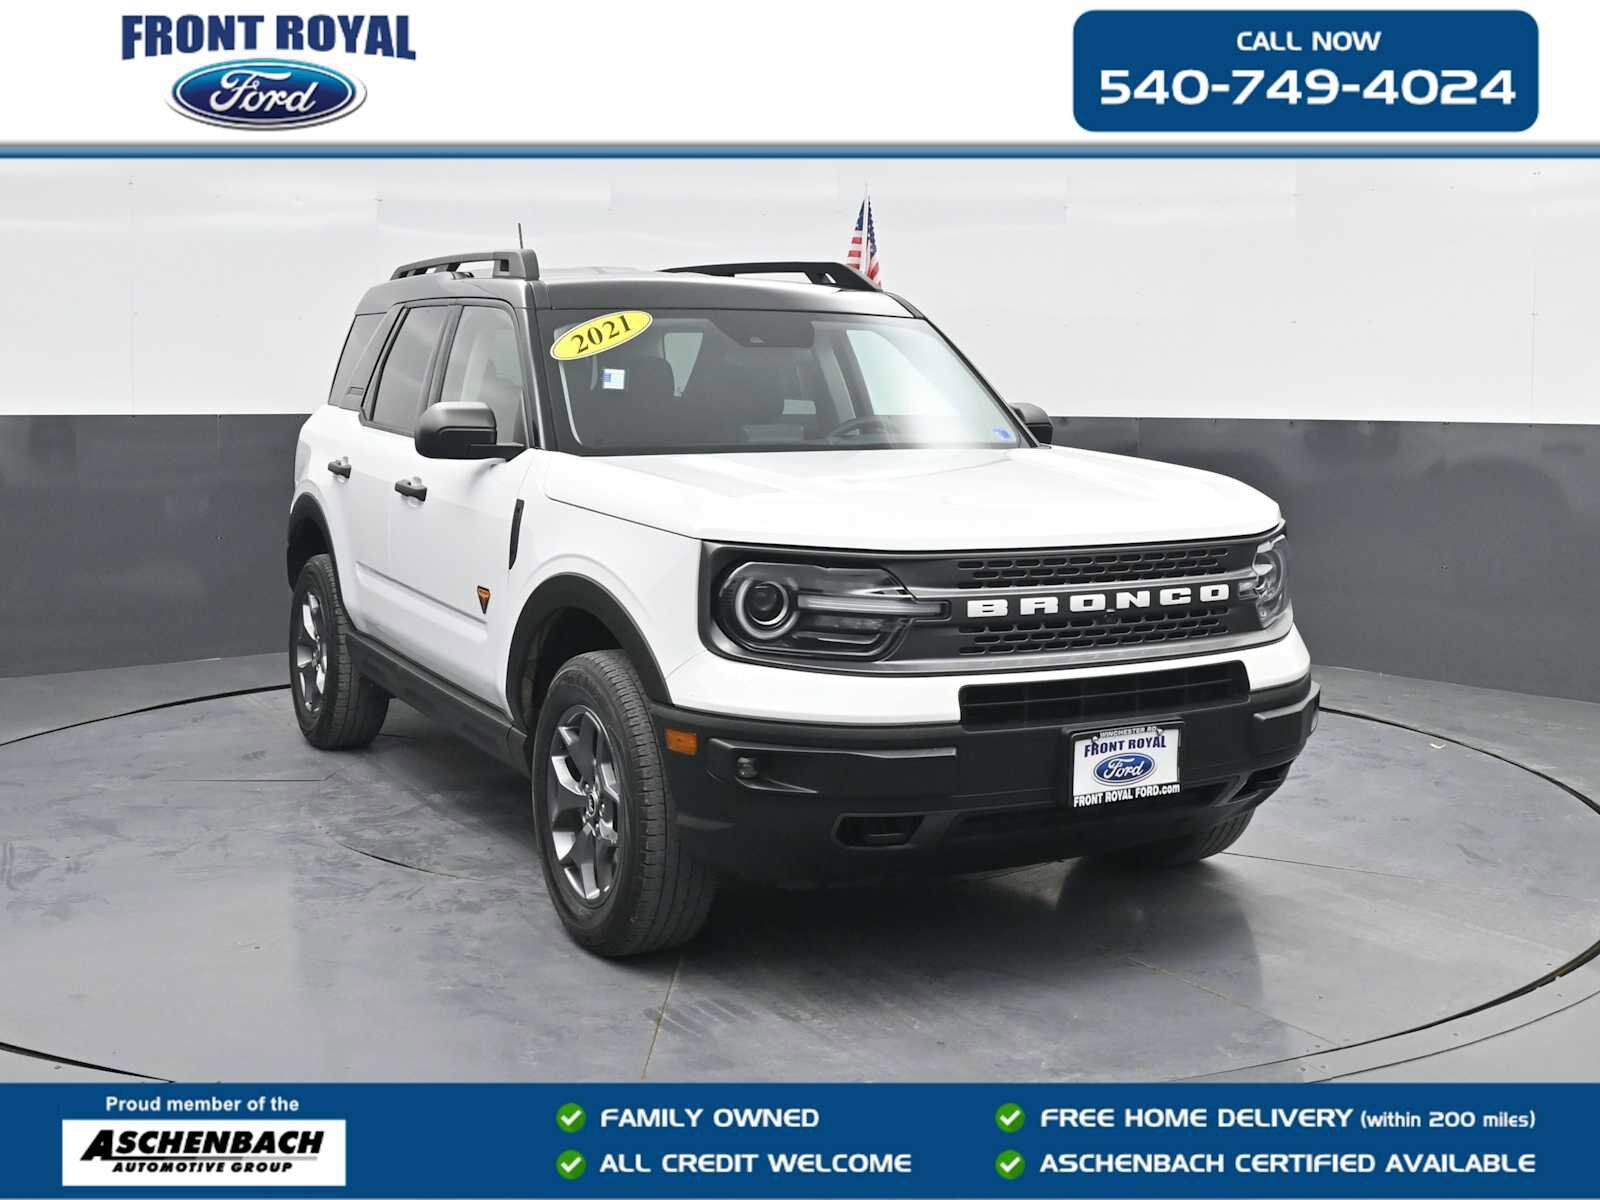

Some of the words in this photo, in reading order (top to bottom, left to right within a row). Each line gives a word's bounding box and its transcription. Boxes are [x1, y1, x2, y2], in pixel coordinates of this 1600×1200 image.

[571, 314, 631, 354] 2021
[967, 584, 1230, 618] BRONCO
[1084, 740, 1125, 757] FRONT
[1128, 735, 1167, 750] ROYAL
[1103, 758, 1145, 779] Ford
[1073, 793, 1104, 808] FRONT
[1105, 789, 1134, 803] ROYAL
[1135, 783, 1181, 799] FORD.com
